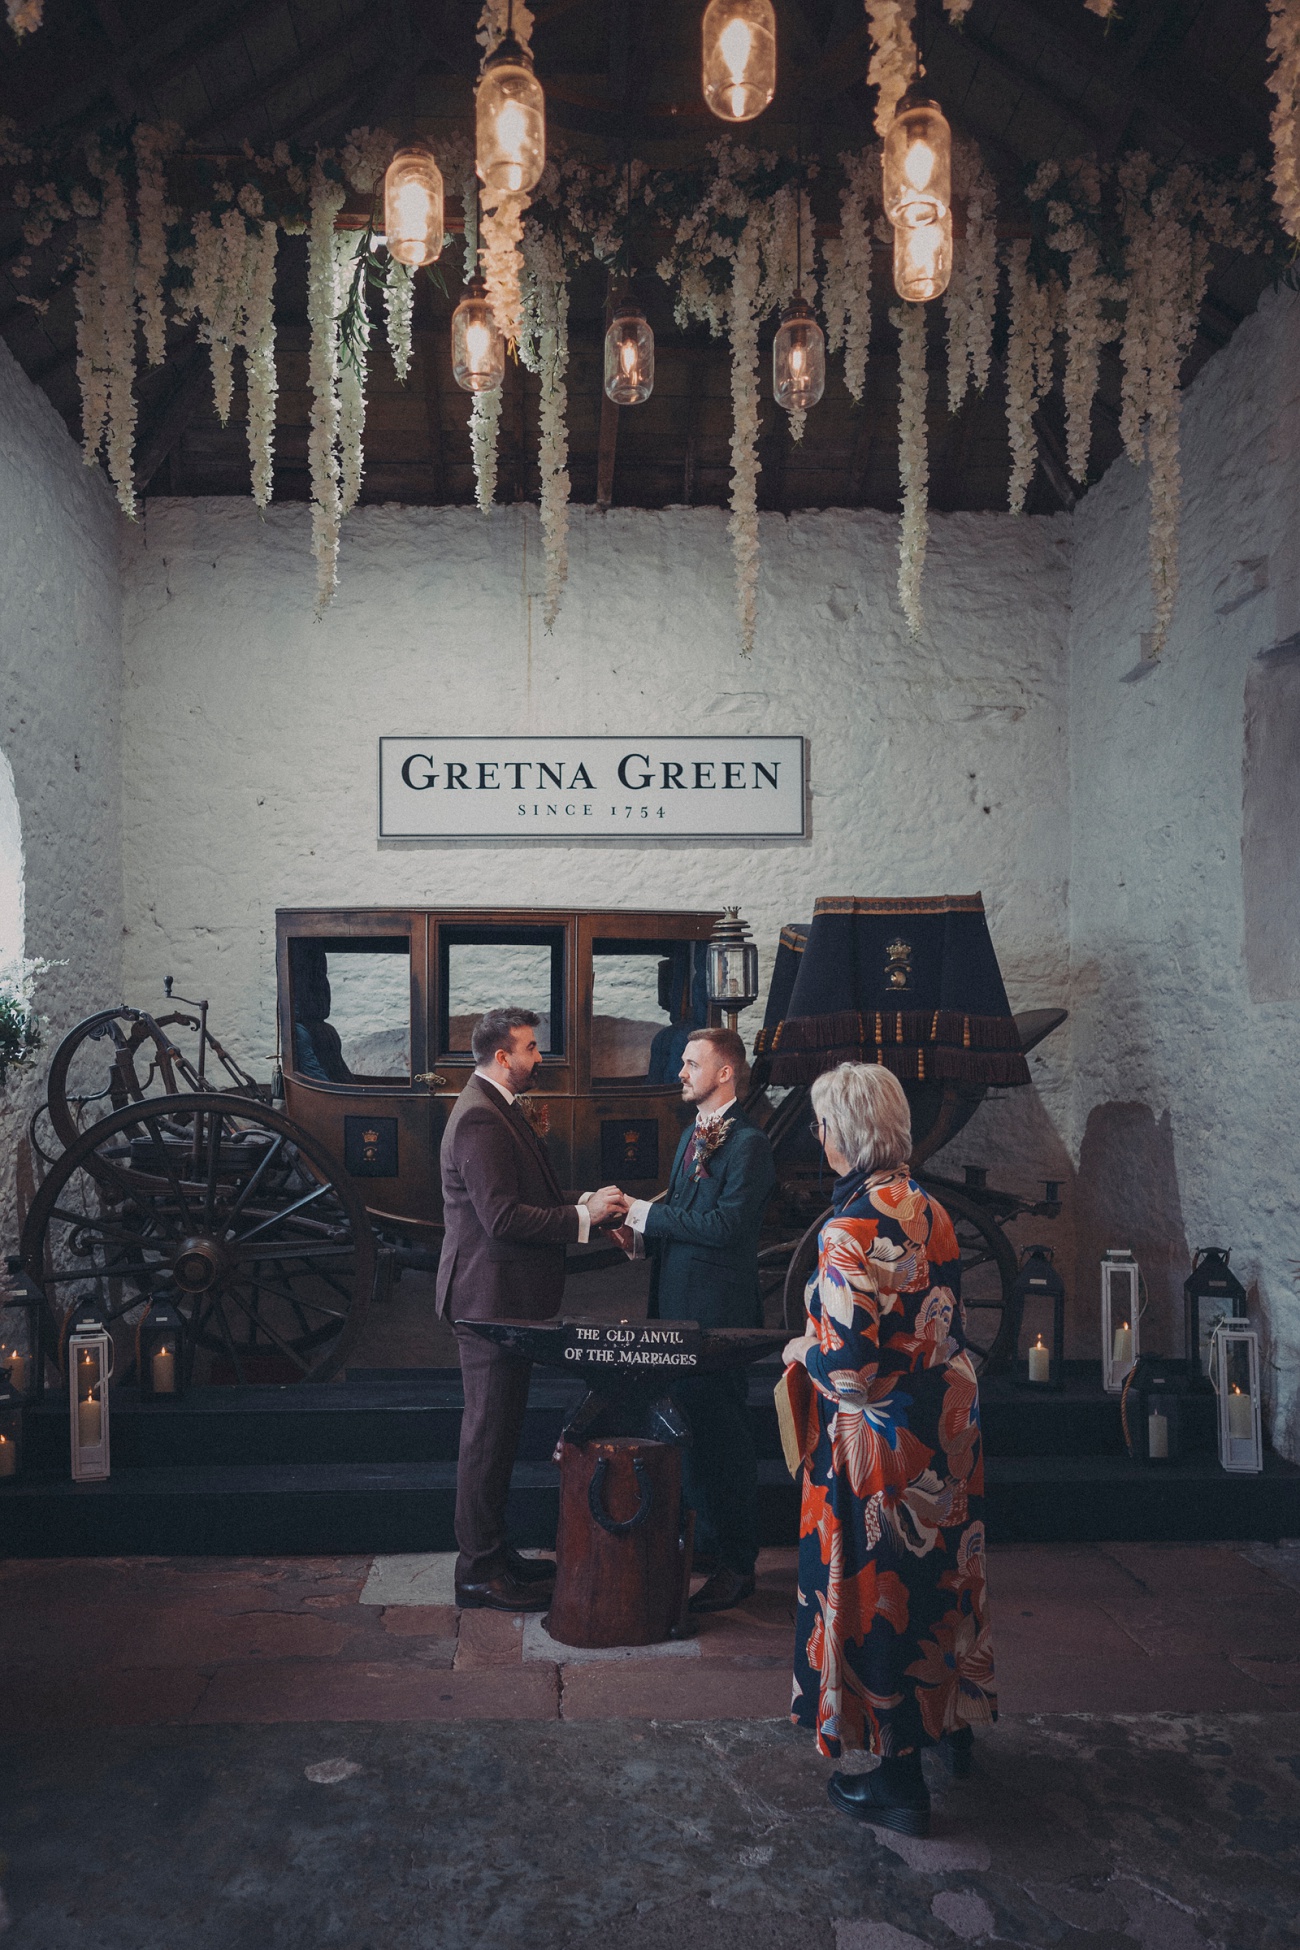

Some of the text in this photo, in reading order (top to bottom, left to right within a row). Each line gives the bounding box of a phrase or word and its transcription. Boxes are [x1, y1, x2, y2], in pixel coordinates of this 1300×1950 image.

[401, 753, 781, 790] GRETNA GREEN
[518, 804, 666, 819] SINCE 1754
[576, 1328, 683, 1344] THE OLD ANVIL
[564, 1348, 697, 1365] OF THE MARRIAGES
